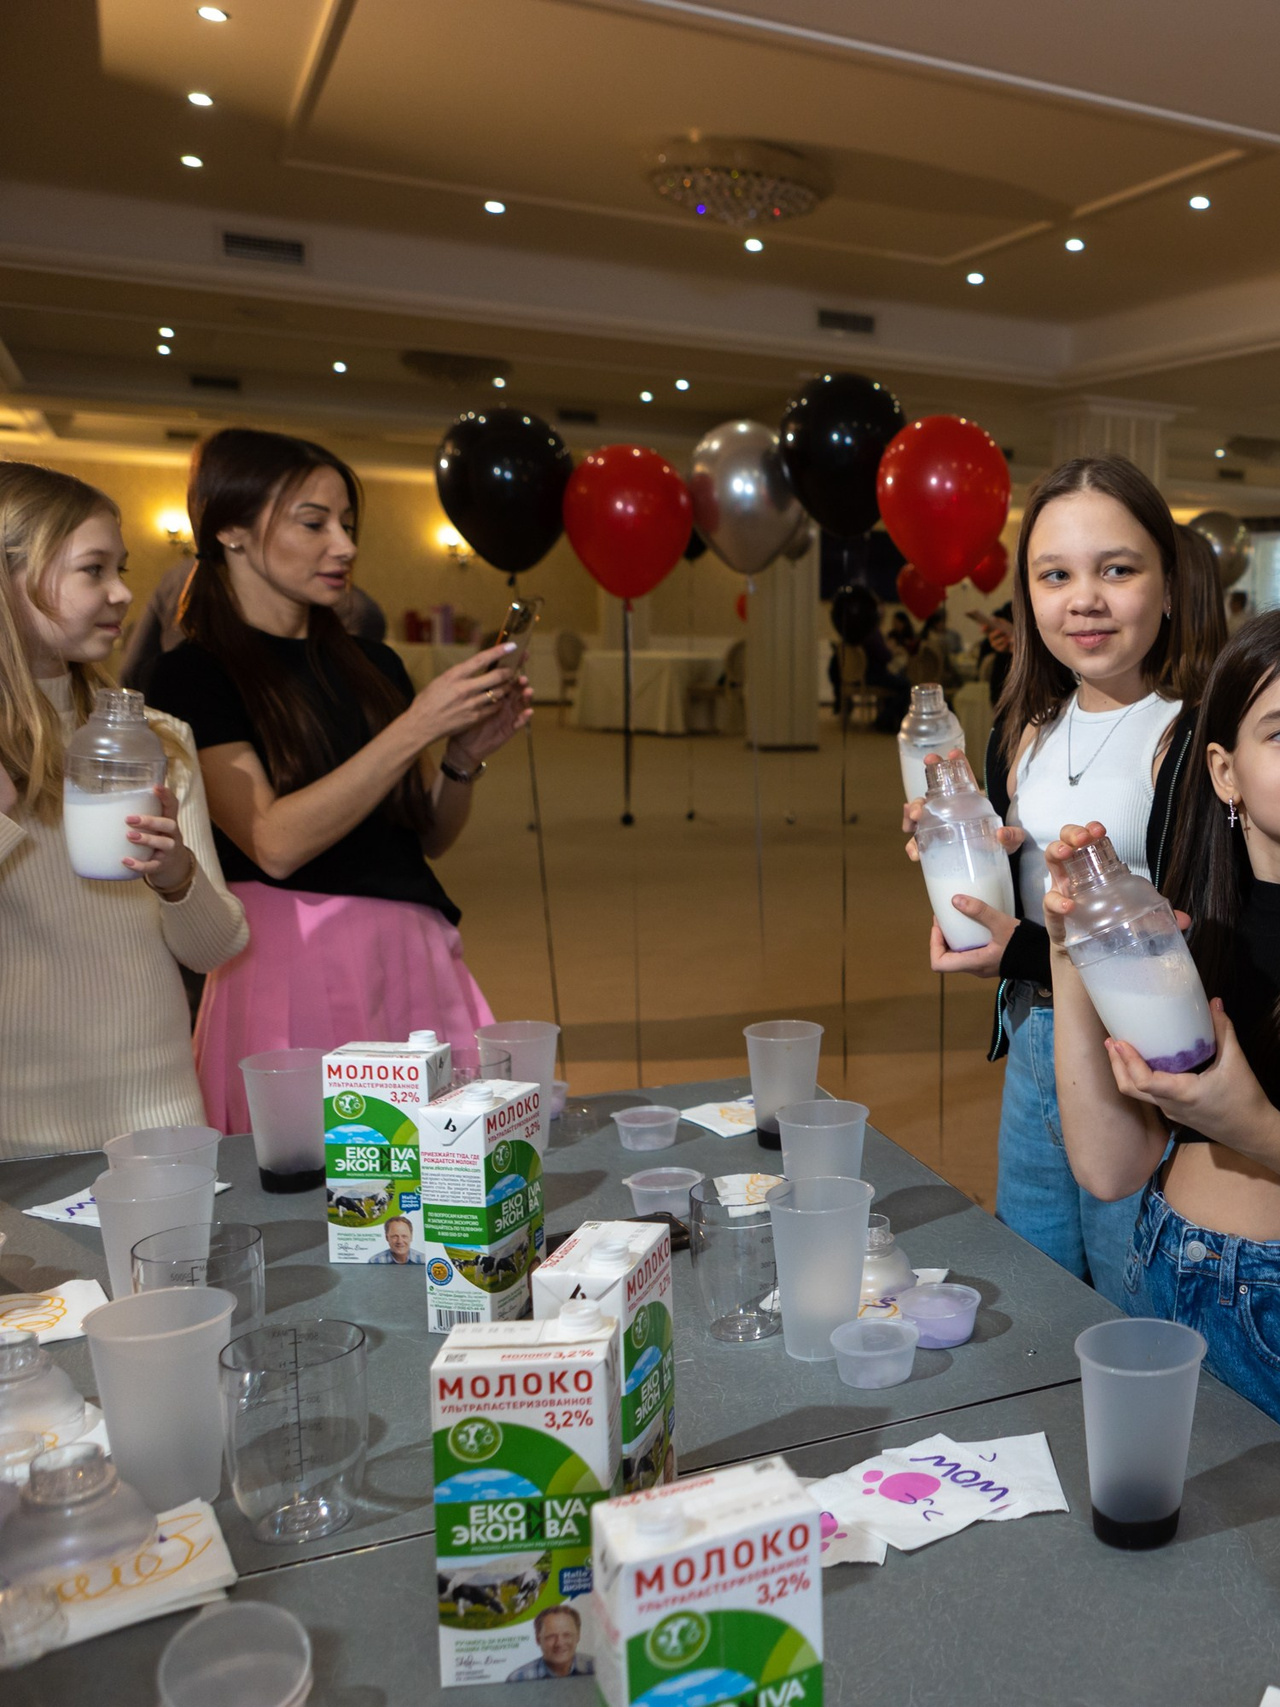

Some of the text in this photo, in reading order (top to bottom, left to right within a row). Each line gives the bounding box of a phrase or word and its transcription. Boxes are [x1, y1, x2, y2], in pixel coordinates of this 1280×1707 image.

[327, 1064, 419, 1081] МОЛОКО
[390, 1091, 420, 1103] 3,2%
[486, 1093, 540, 1134] МОЛОКО
[524, 1121, 540, 1138] 3,2%
[626, 1237, 670, 1301] МОЛОКО
[552, 1349, 595, 1359] 3,2%
[438, 1370, 593, 1401] МОЛОКО
[441, 1397, 593, 1414] УЛЬТРАПАСТЕРИЗОВАННОЕ
[544, 1410, 594, 1431] 3,2%
[634, 1523, 810, 1598] МОЛОКО
[757, 1571, 811, 1606] 3,2%
